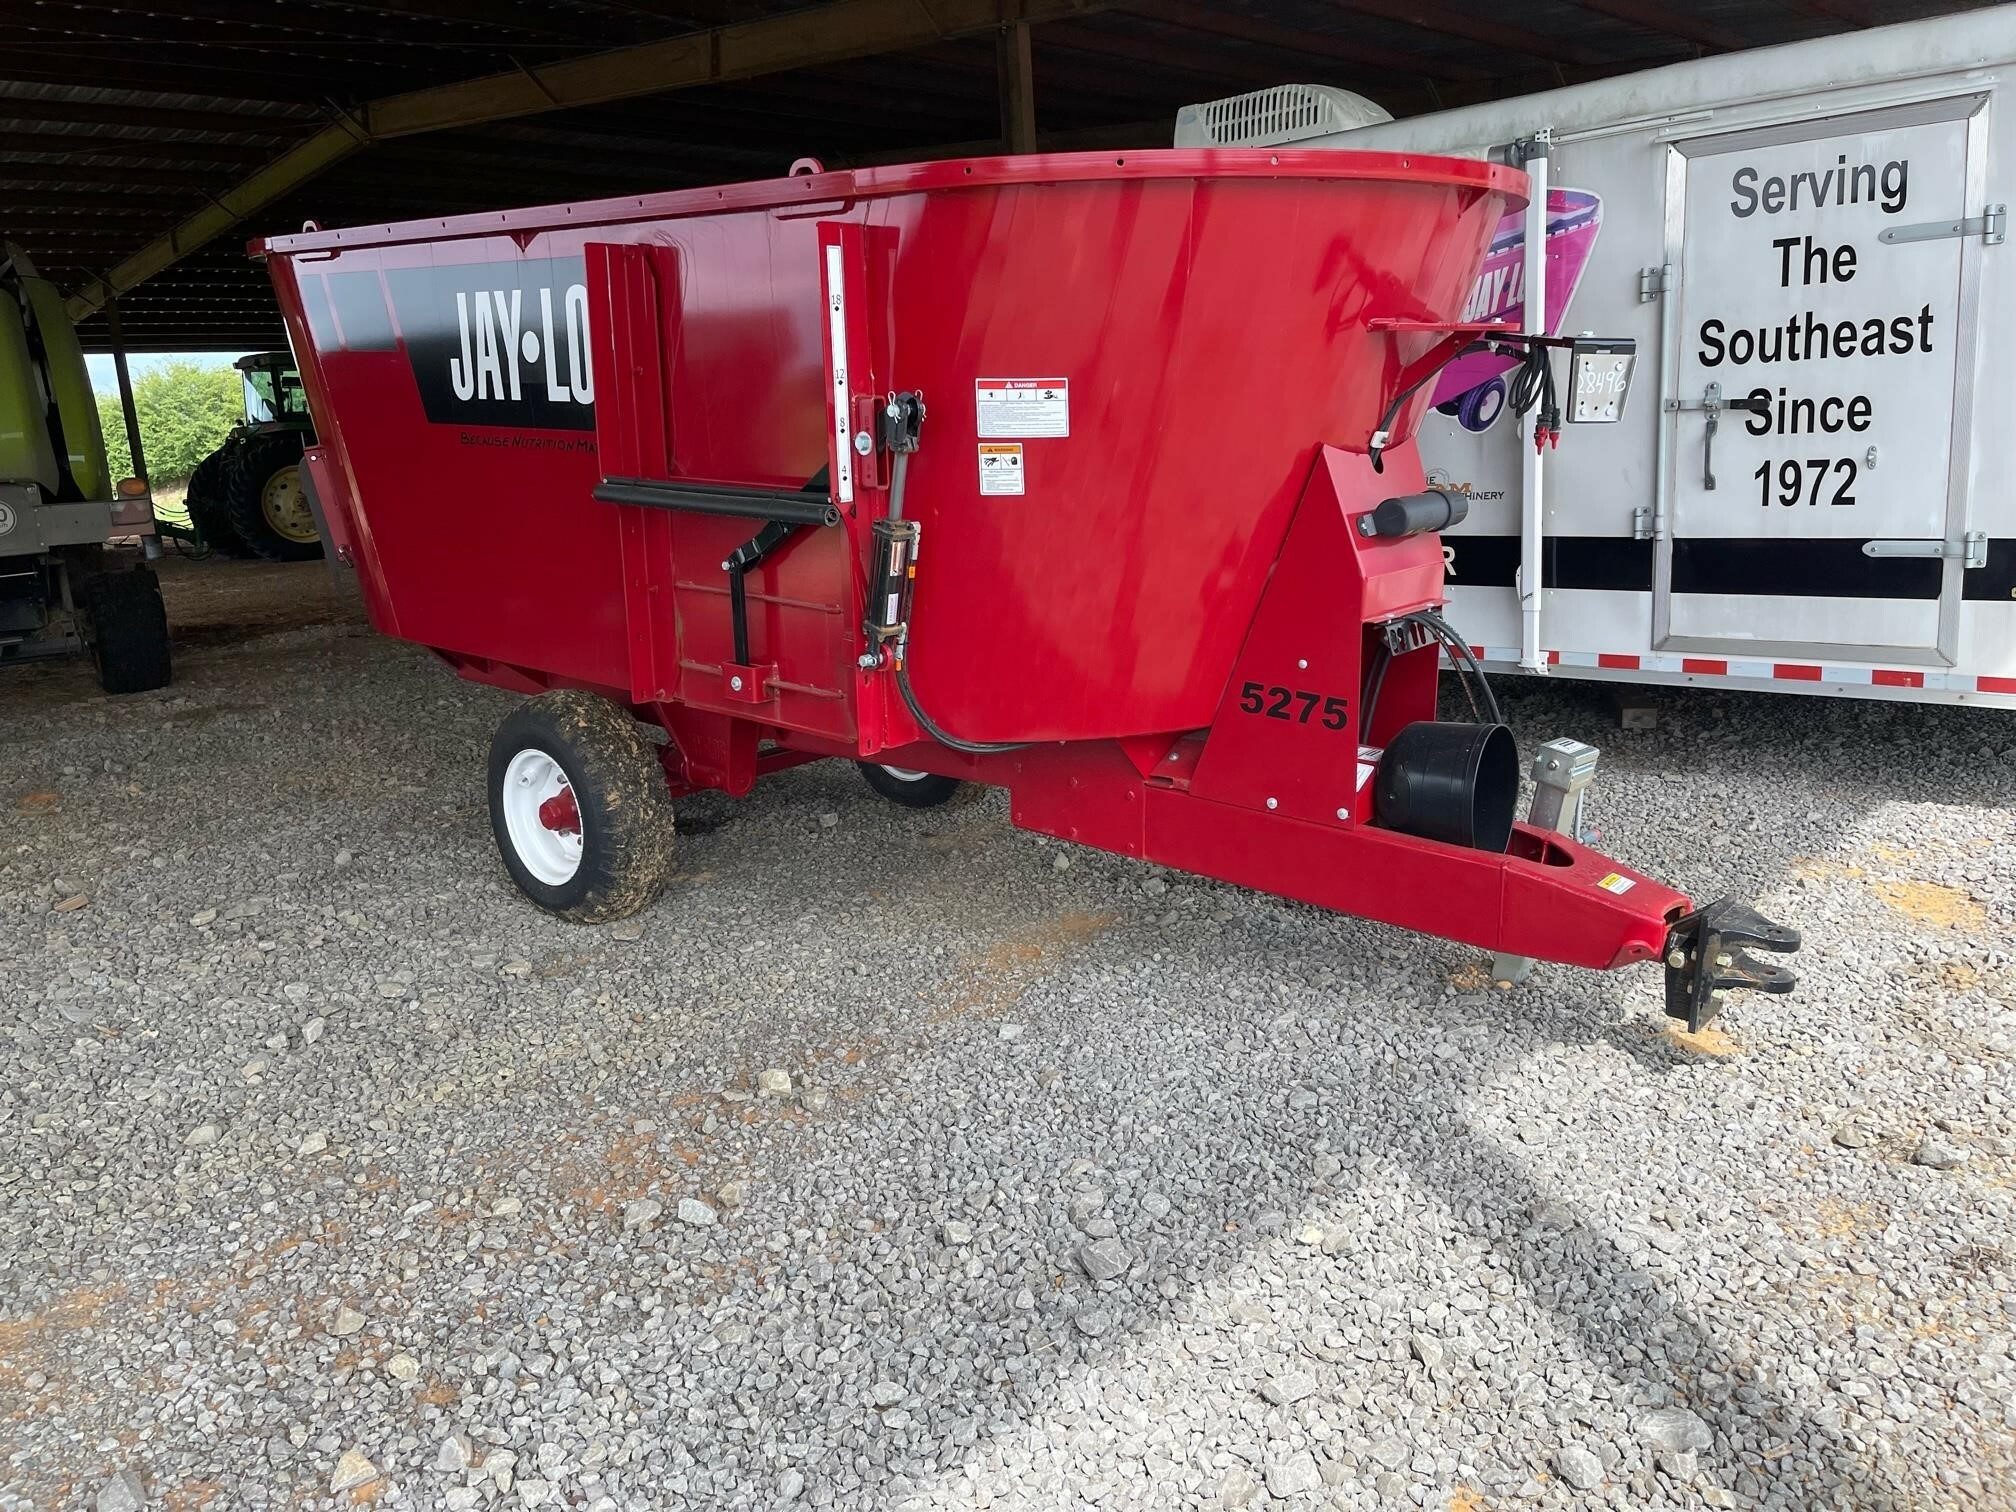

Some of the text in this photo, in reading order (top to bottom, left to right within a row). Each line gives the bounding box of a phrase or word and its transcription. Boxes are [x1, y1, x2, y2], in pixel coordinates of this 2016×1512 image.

[1730, 154, 1909, 218] Serving
[1772, 235, 1857, 288] The
[830, 294, 842, 305] 18
[1698, 303, 1934, 368] Southeast
[834, 369, 846, 380] 12
[1577, 370, 1627, 394] 28496
[839, 417, 846, 428] 8
[1745, 388, 1872, 436] Since
[841, 465, 848, 475] 4
[1753, 457, 1858, 507] 1972
[1239, 681, 1348, 730] 5275
